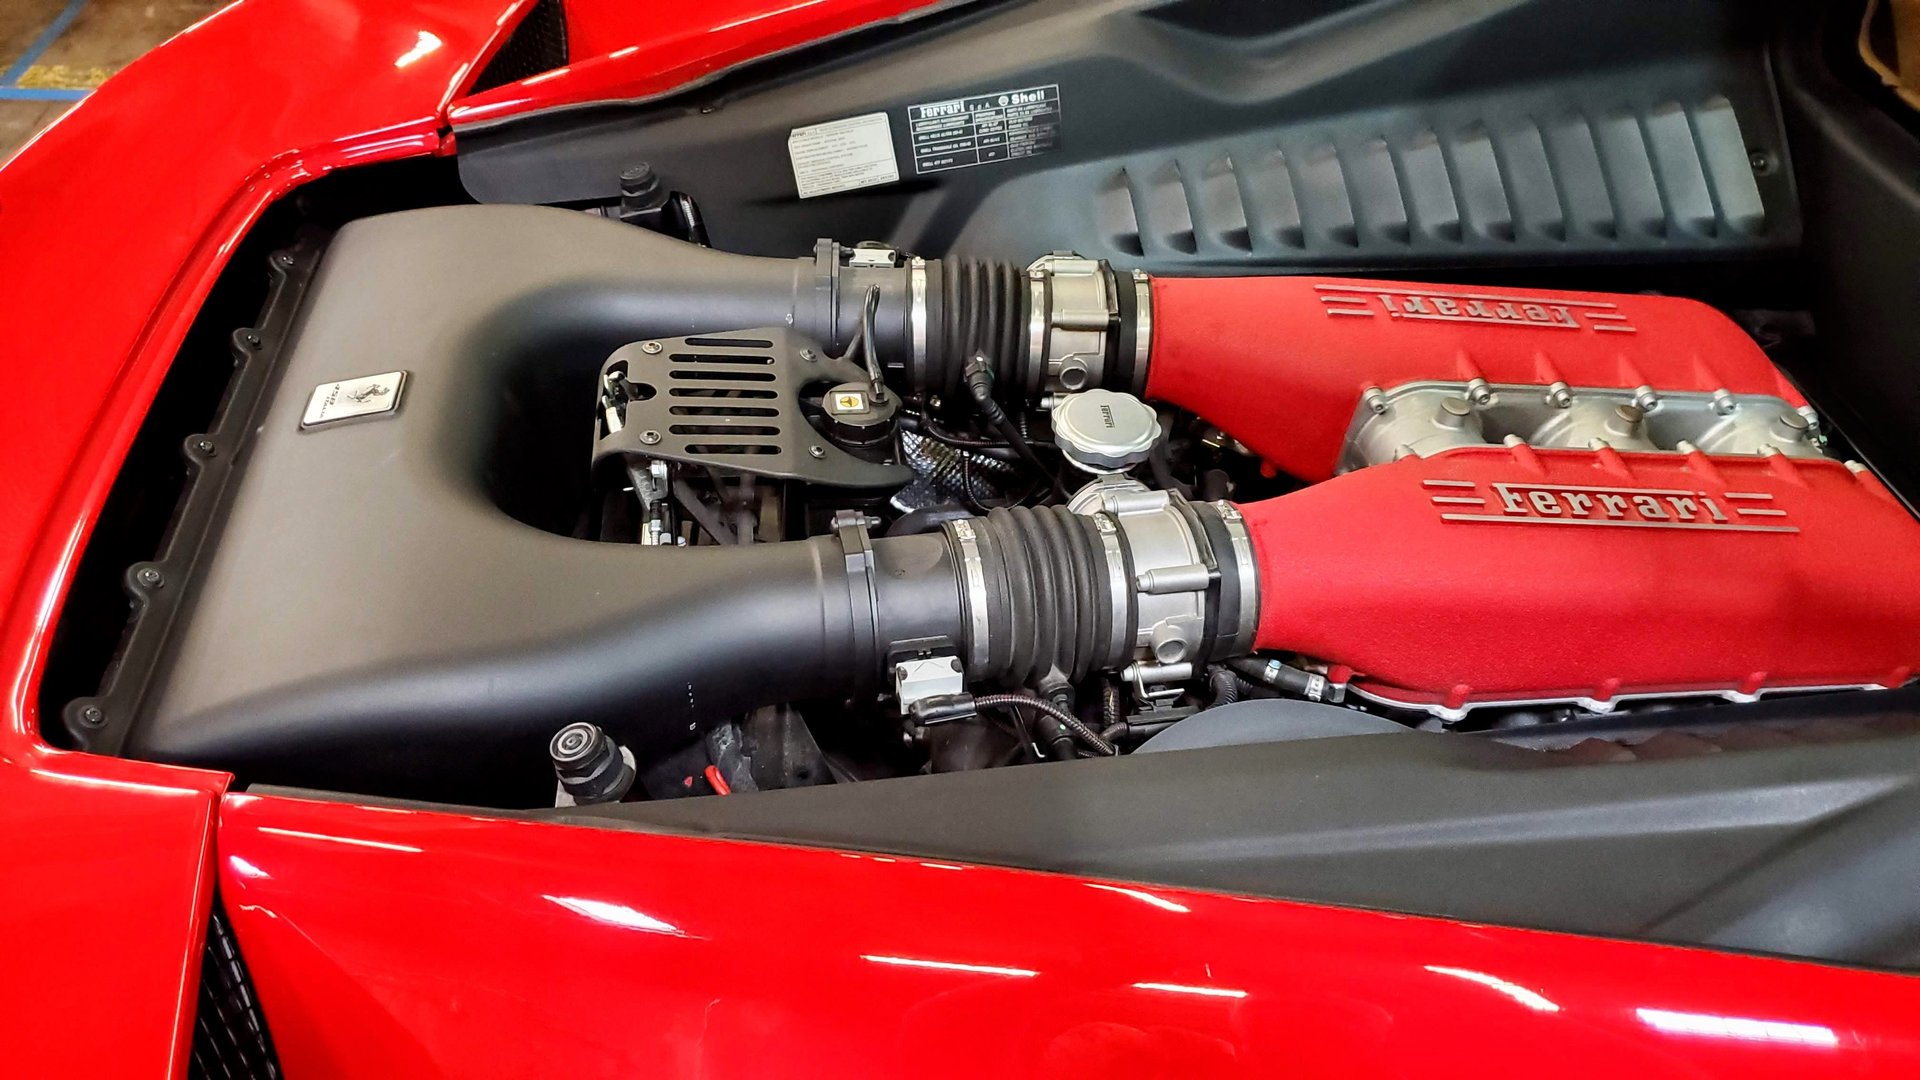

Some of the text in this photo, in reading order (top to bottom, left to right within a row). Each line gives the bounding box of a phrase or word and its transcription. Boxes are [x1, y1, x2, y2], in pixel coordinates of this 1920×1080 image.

[920, 100, 965, 118] Ferrari
[1011, 90, 1045, 105] Shell
[1378, 294, 1580, 328] Ferrari
[1100, 405, 1115, 428] Ferrari
[1491, 482, 1728, 521] Ferrari
